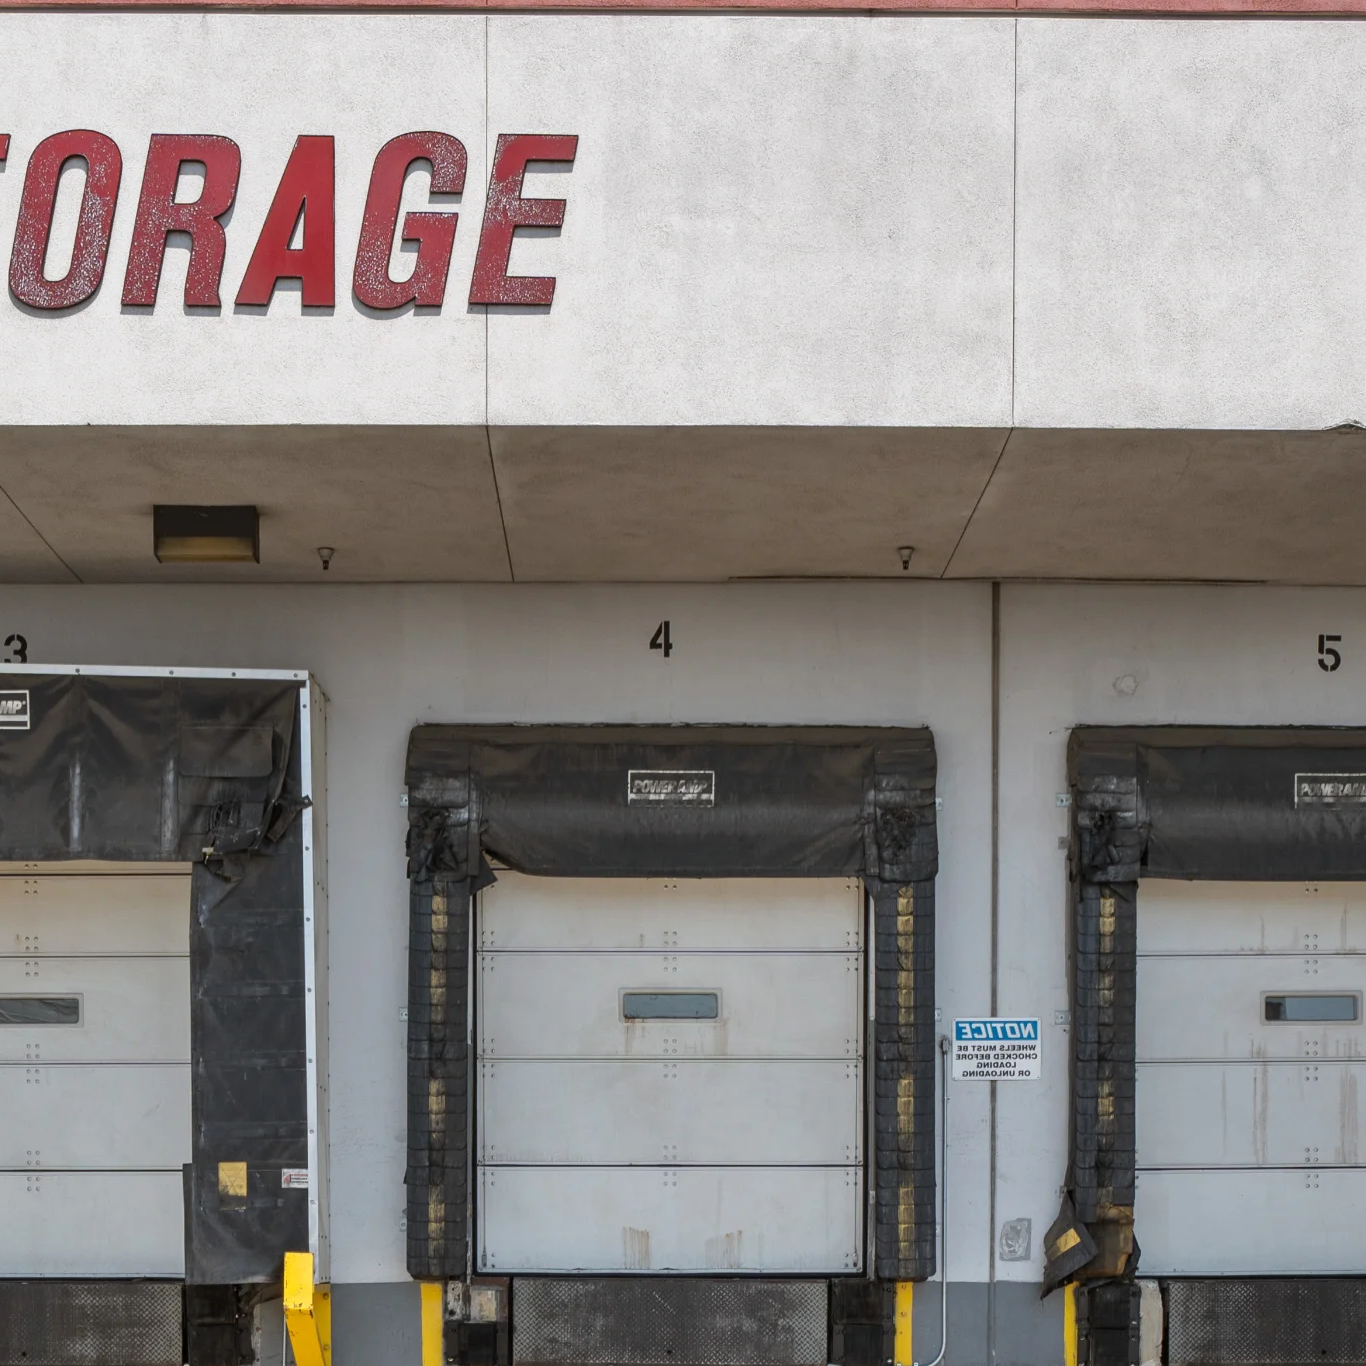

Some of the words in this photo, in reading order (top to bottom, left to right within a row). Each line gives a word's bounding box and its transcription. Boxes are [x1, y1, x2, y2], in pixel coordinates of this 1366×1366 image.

[4, 633, 28, 663] 3
[649, 620, 673, 657] 4
[1318, 634, 1342, 672] 5
